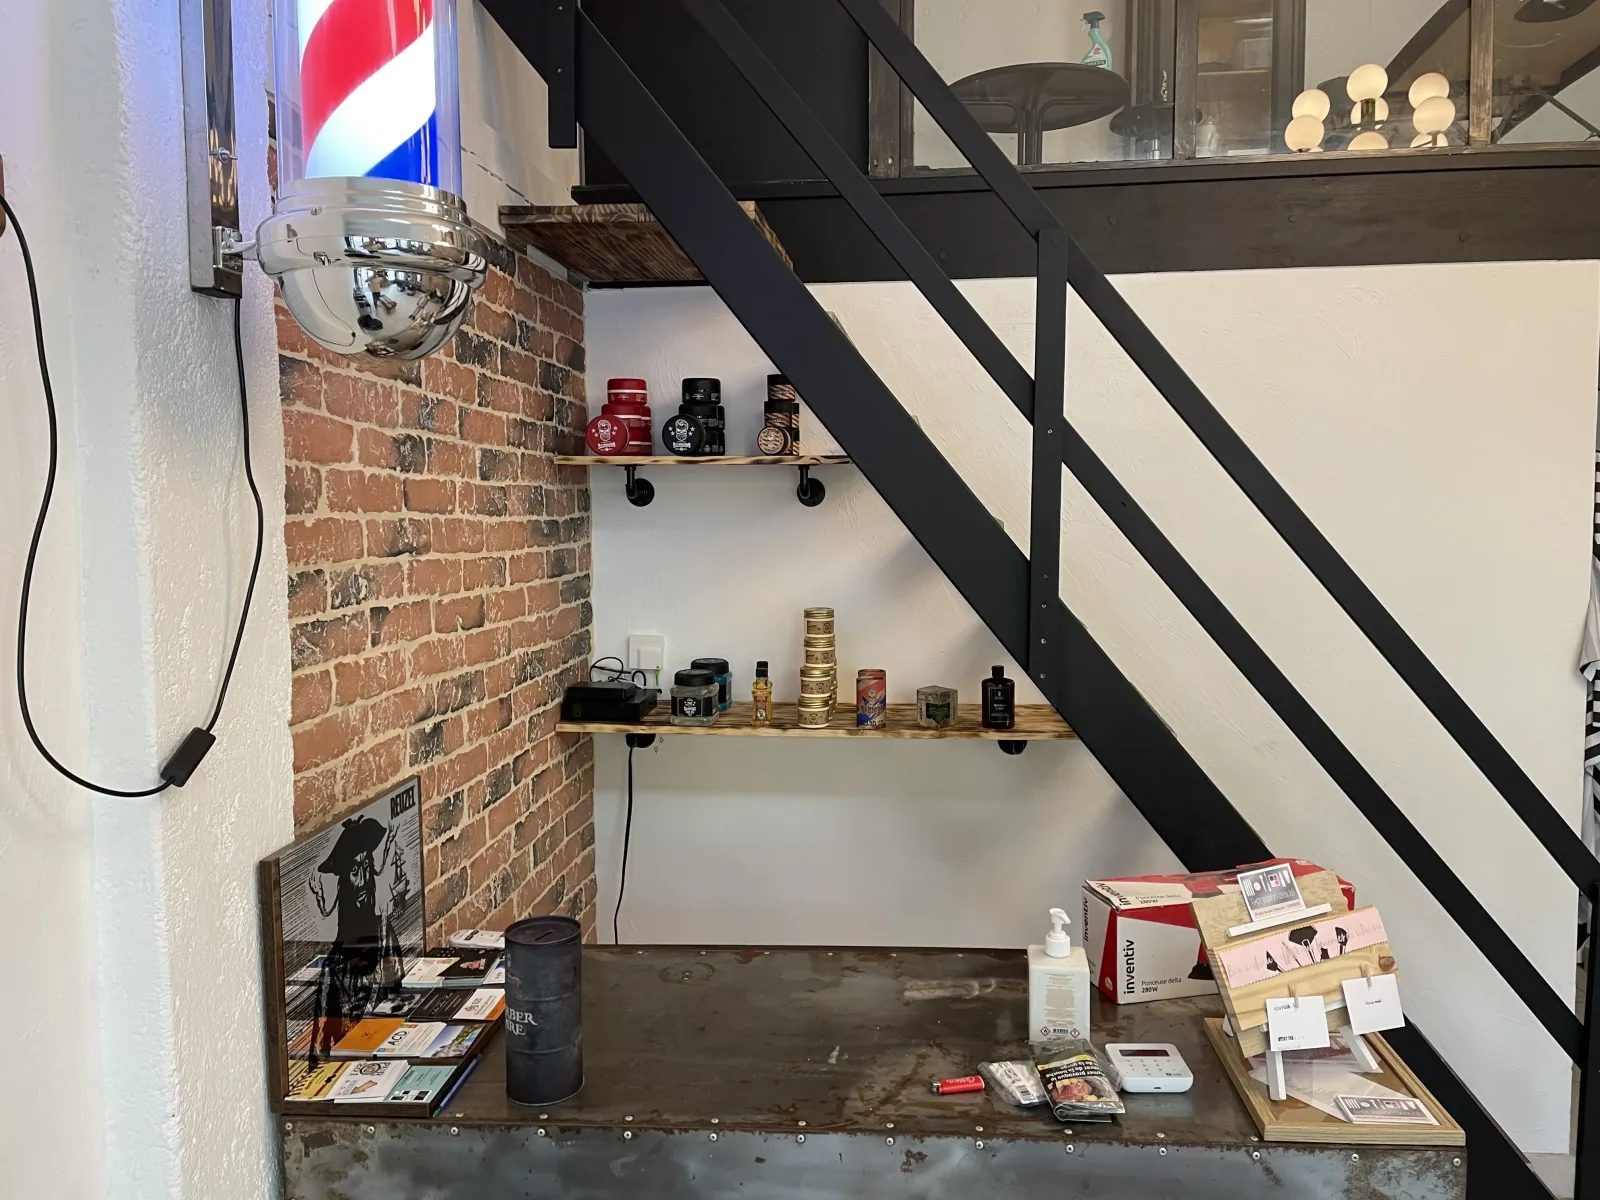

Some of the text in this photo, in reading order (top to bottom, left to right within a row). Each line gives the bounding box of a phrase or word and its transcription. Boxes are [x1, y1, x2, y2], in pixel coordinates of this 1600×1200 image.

[390, 785, 416, 821] REUZEL
[1123, 939, 1135, 994] inventiv
[1141, 977, 1182, 988] Ponceuse delta
[1141, 986, 1158, 994] 280W
[388, 1030, 408, 1046] ACD
